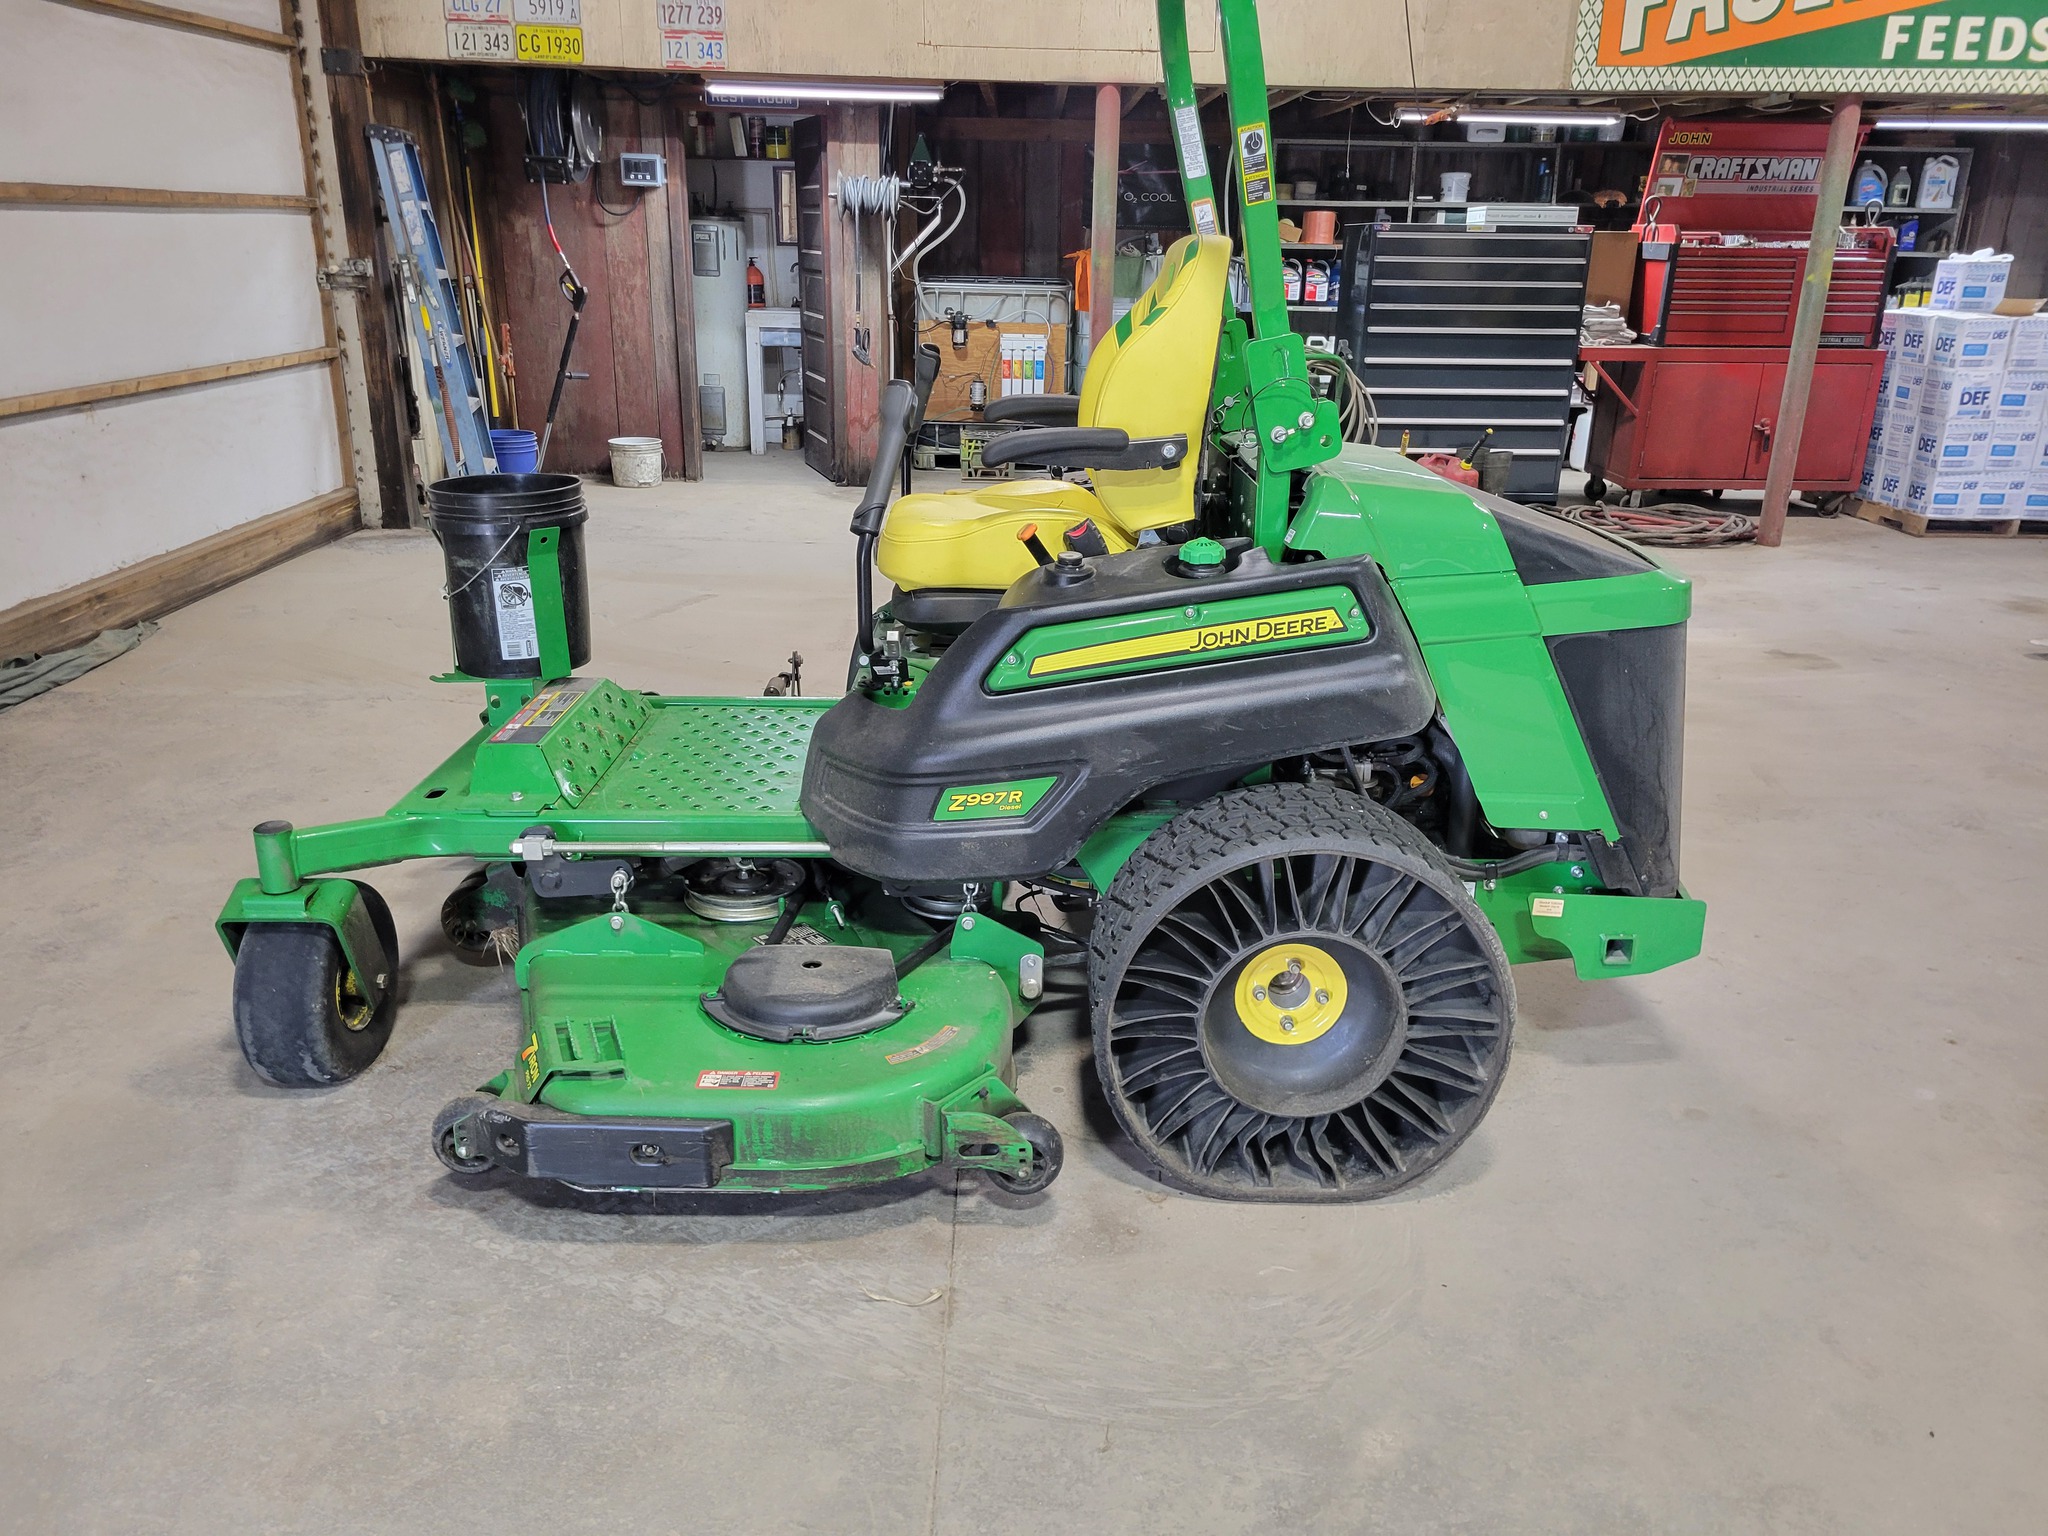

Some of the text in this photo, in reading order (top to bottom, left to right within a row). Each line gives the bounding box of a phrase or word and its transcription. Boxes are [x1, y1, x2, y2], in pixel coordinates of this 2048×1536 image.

[529, 0, 564, 16] 5919
[662, 5, 722, 25] 1277 239
[454, 32, 510, 52] 121 343
[518, 34, 580, 55] CG 1930
[668, 40, 723, 60] 121 343
[1668, 132, 1712, 145] JOHN
[1686, 156, 1822, 182] CRAFTSMAN
[1990, 273, 2006, 282] DEF
[1936, 280, 1957, 294] DEF
[1880, 330, 1896, 346] DEF
[1904, 330, 1924, 348] DEF
[1992, 331, 2008, 340] DEF
[1936, 336, 1956, 352] DEF
[1878, 380, 1889, 394] EF
[1912, 377, 1922, 386] DEF
[1941, 382, 1952, 390] DEF
[2030, 382, 2046, 391] DEF
[1960, 390, 1991, 406] DEF
[1904, 426, 1914, 434] DEF
[1972, 432, 1989, 441] DEF
[2020, 432, 2036, 441] DEF
[1918, 438, 1937, 453] DEF
[1882, 478, 1899, 492] DEF
[1909, 484, 1926, 500] DEF
[1962, 482, 1979, 490] DEF
[2009, 481, 2025, 490] DEF
[1190, 616, 1328, 649] JOHN DEERE
[948, 790, 1023, 812] Z997R
